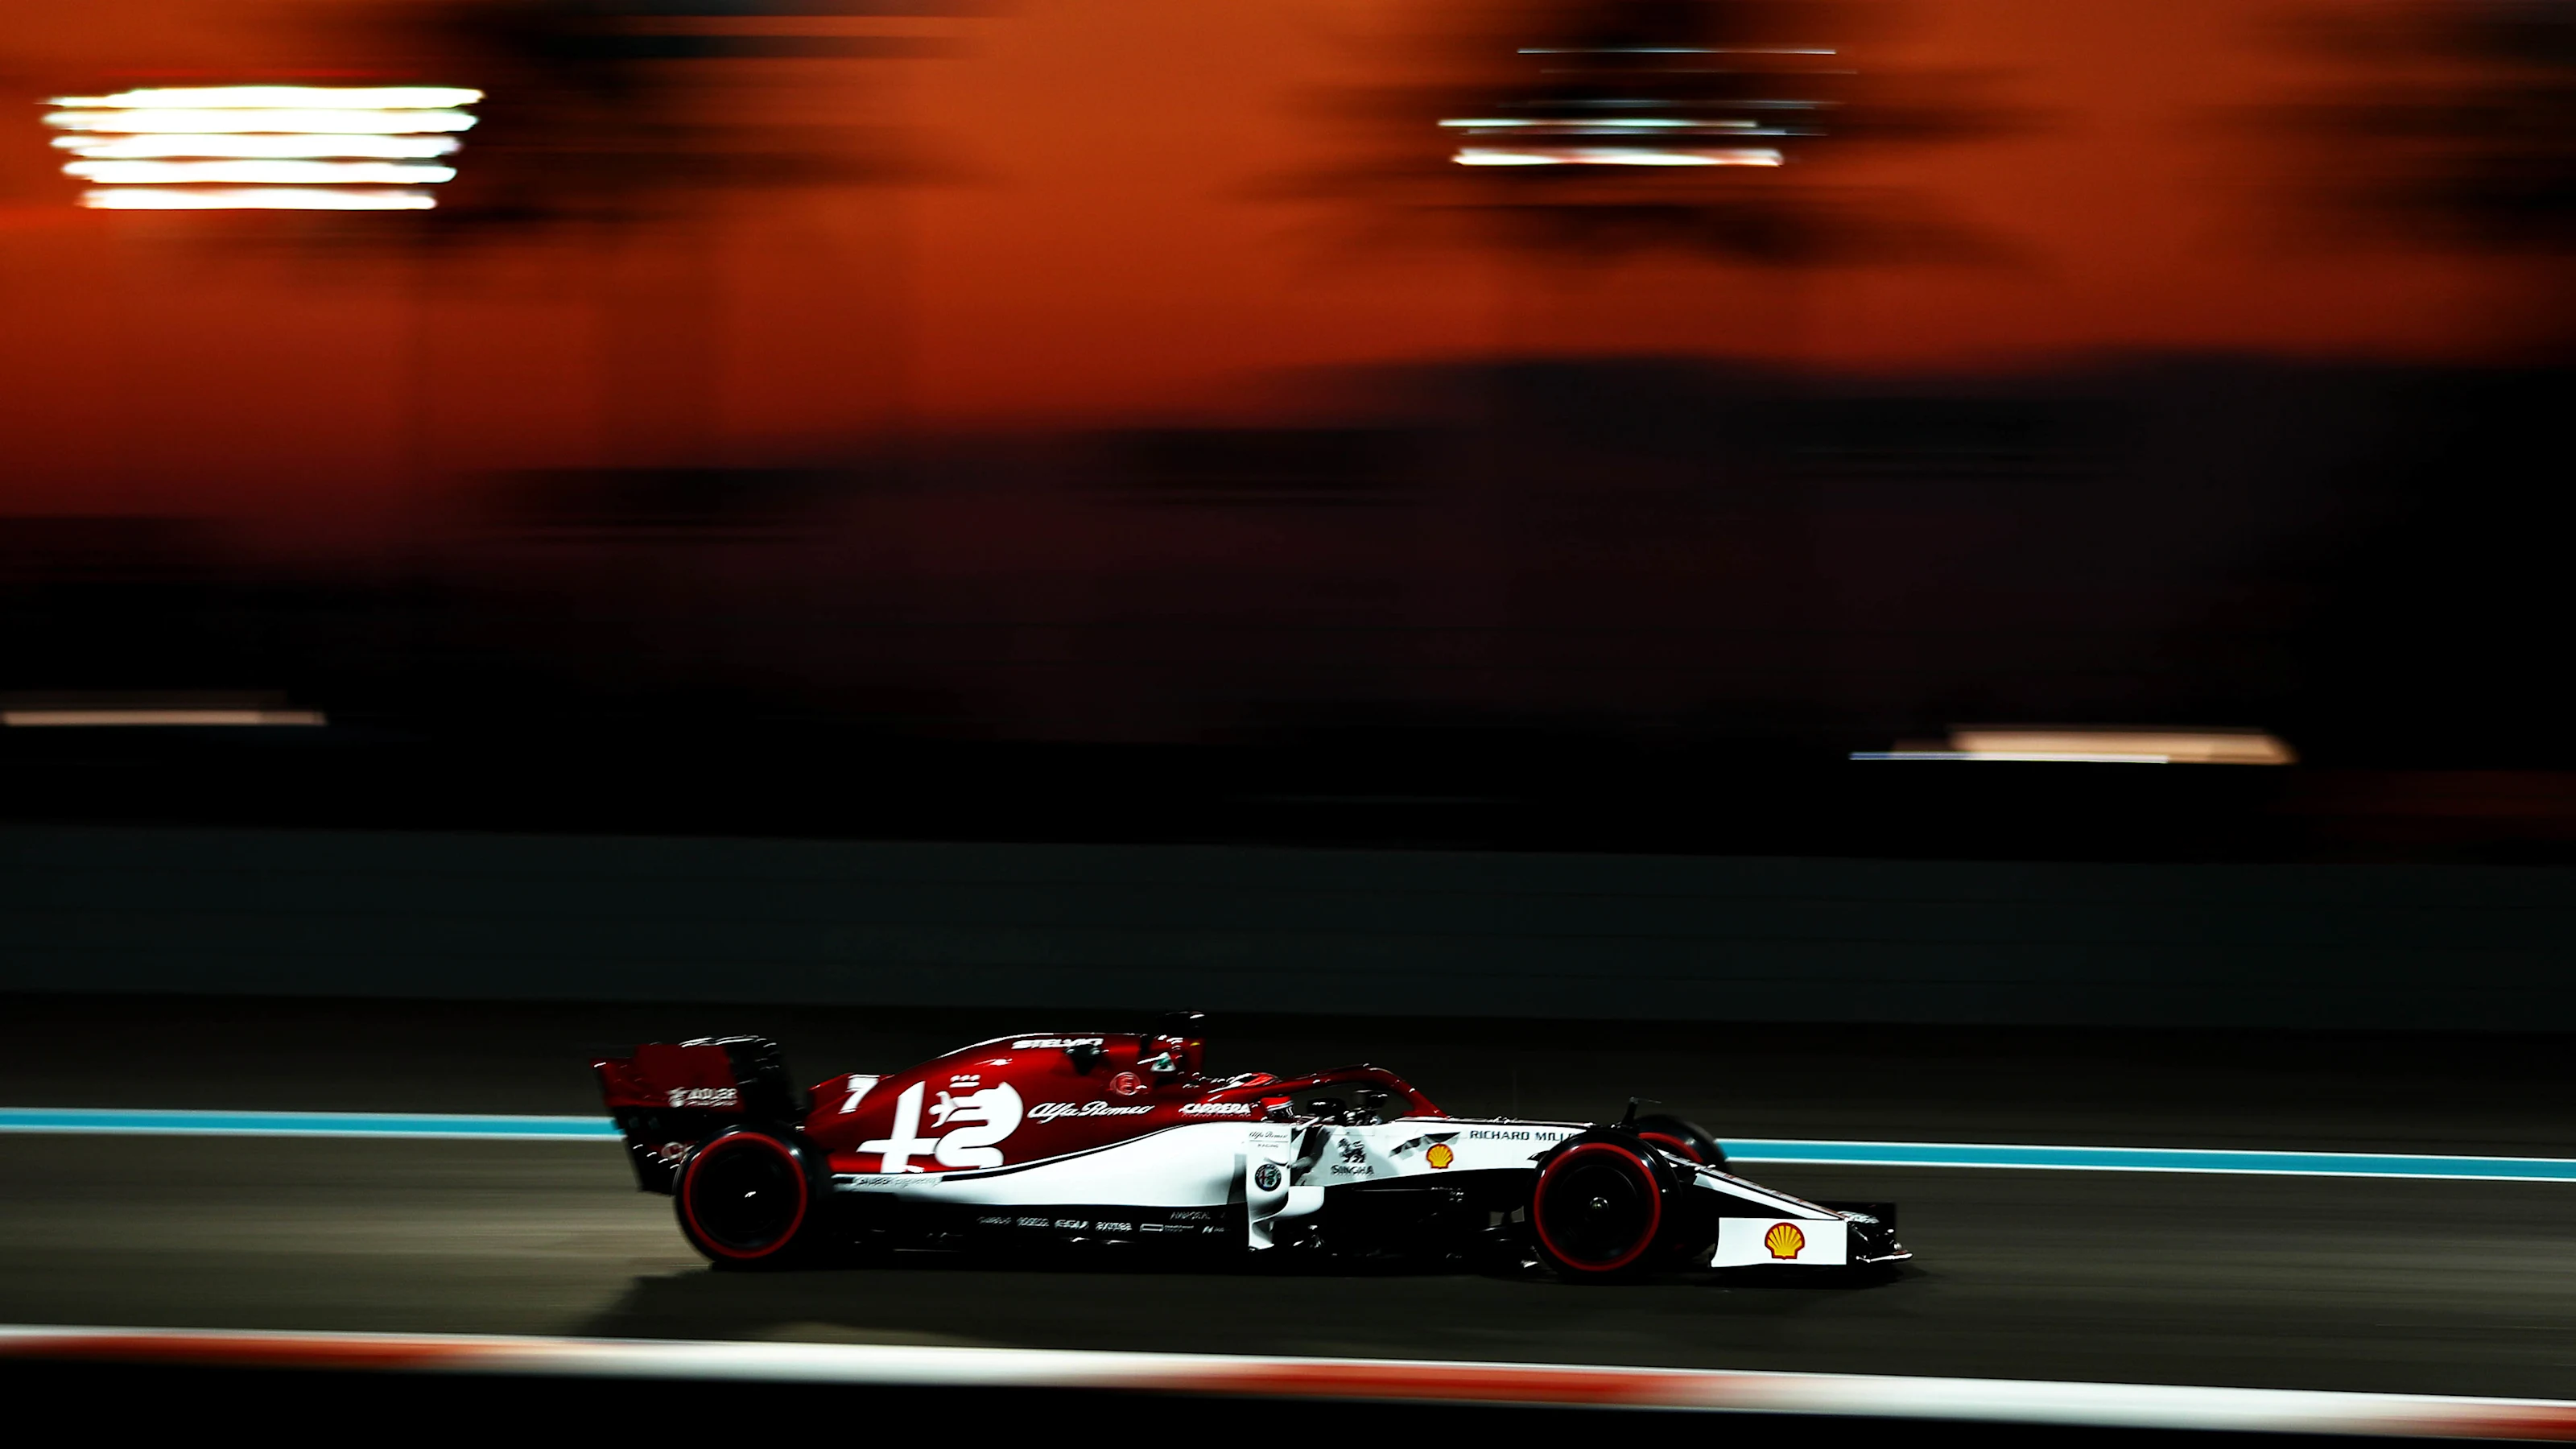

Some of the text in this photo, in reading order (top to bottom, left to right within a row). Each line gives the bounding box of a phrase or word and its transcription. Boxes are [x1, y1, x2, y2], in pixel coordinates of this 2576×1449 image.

[838, 1074, 880, 1114] 7
[1027, 1100, 1155, 1124] Alfa Romeo
[1183, 1103, 1251, 1114] CARRERA
[1470, 1130, 1530, 1141] RICHARD
[1331, 1164, 1374, 1174] SINGHA
